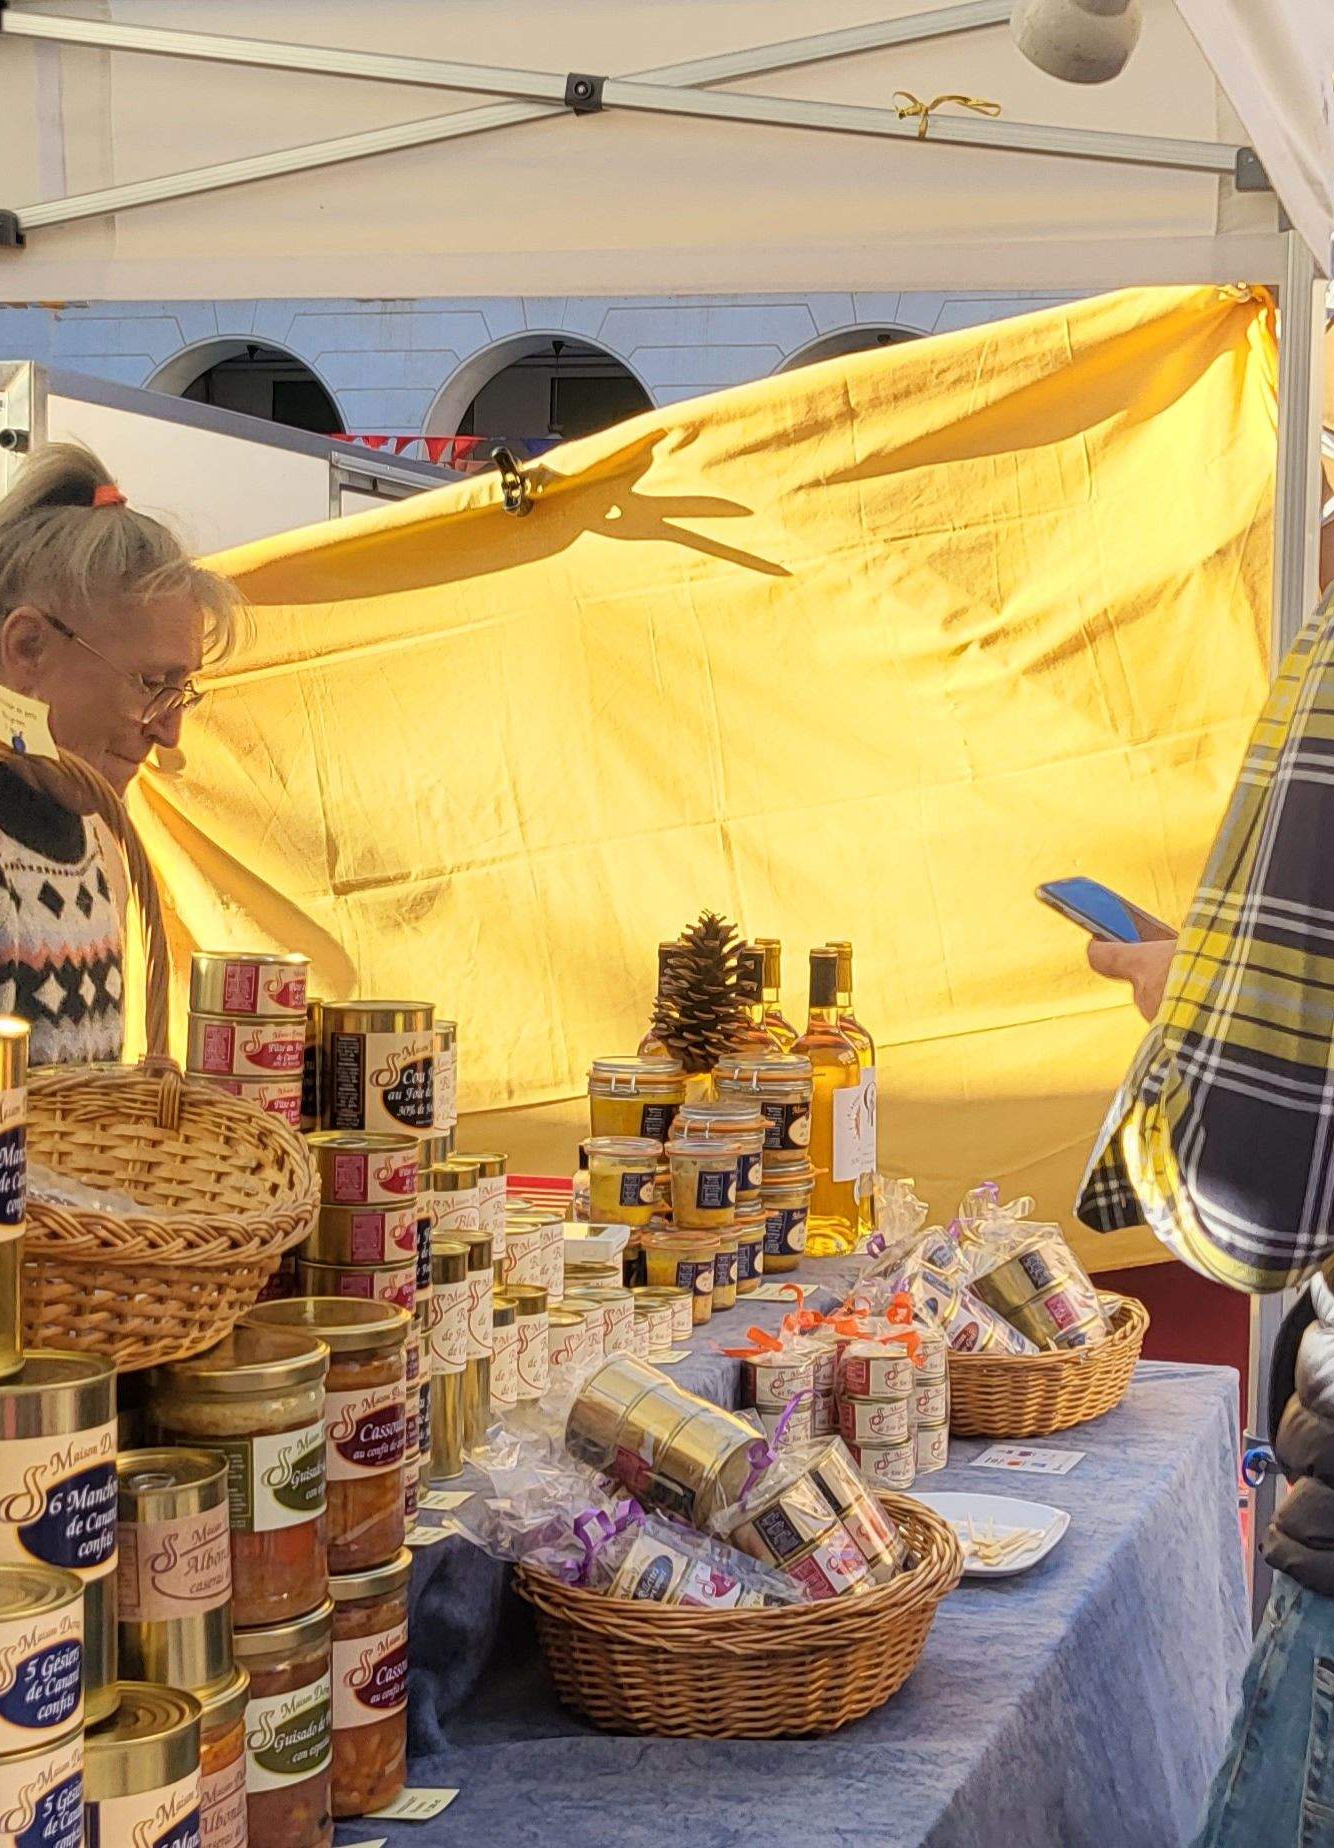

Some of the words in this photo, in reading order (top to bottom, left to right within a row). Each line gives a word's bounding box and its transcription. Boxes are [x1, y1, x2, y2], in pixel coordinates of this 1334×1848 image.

[50, 1440, 99, 1477] Maison
[49, 1493, 64, 1517] 6
[65, 1514, 84, 1540] de
[24, 1657, 40, 1683] 5
[24, 1680, 44, 1704] de
[36, 1690, 76, 1721] confits
[273, 1717, 317, 1754] Guisado
[42, 1792, 56, 1818] 5
[42, 1814, 59, 1839] de
